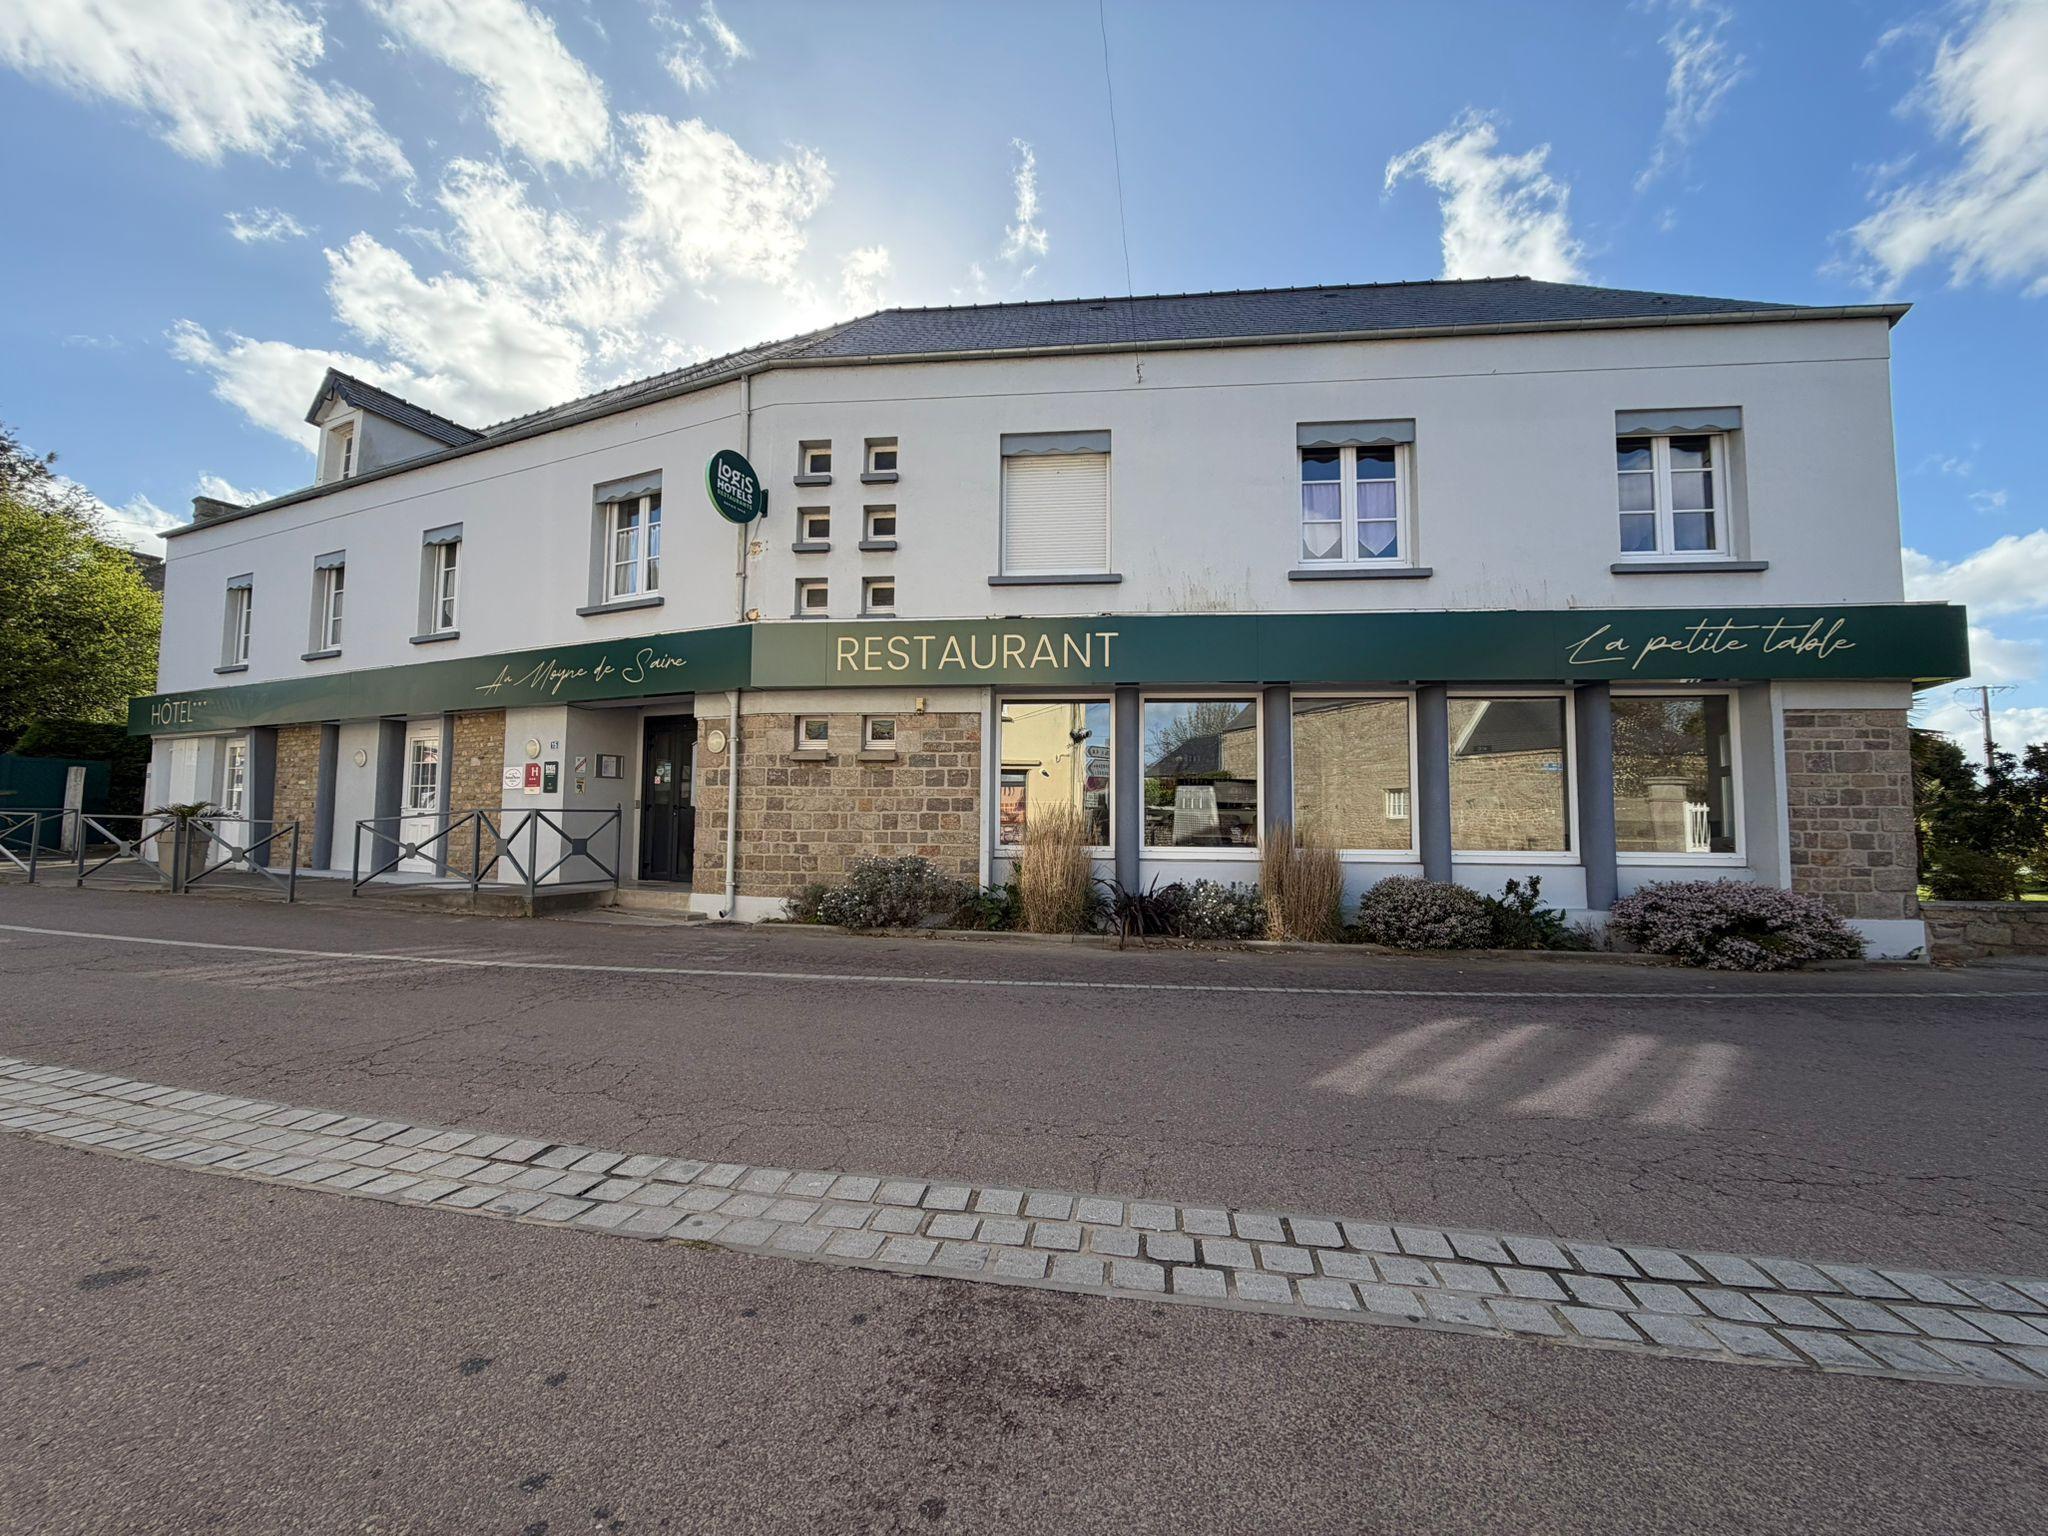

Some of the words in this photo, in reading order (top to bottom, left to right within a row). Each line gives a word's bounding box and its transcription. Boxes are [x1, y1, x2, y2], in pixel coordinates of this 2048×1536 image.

[717, 479, 753, 504] HOTELS
[837, 632, 1119, 671] RESTAURANT
[1565, 624, 1630, 664] La
[1632, 617, 1760, 670] petite
[1761, 617, 1856, 659] table
[475, 664, 513, 696] Au
[513, 659, 588, 695] Moyne
[594, 656, 615, 682] de
[622, 647, 687, 684] Saire
[531, 766, 539, 777] H
